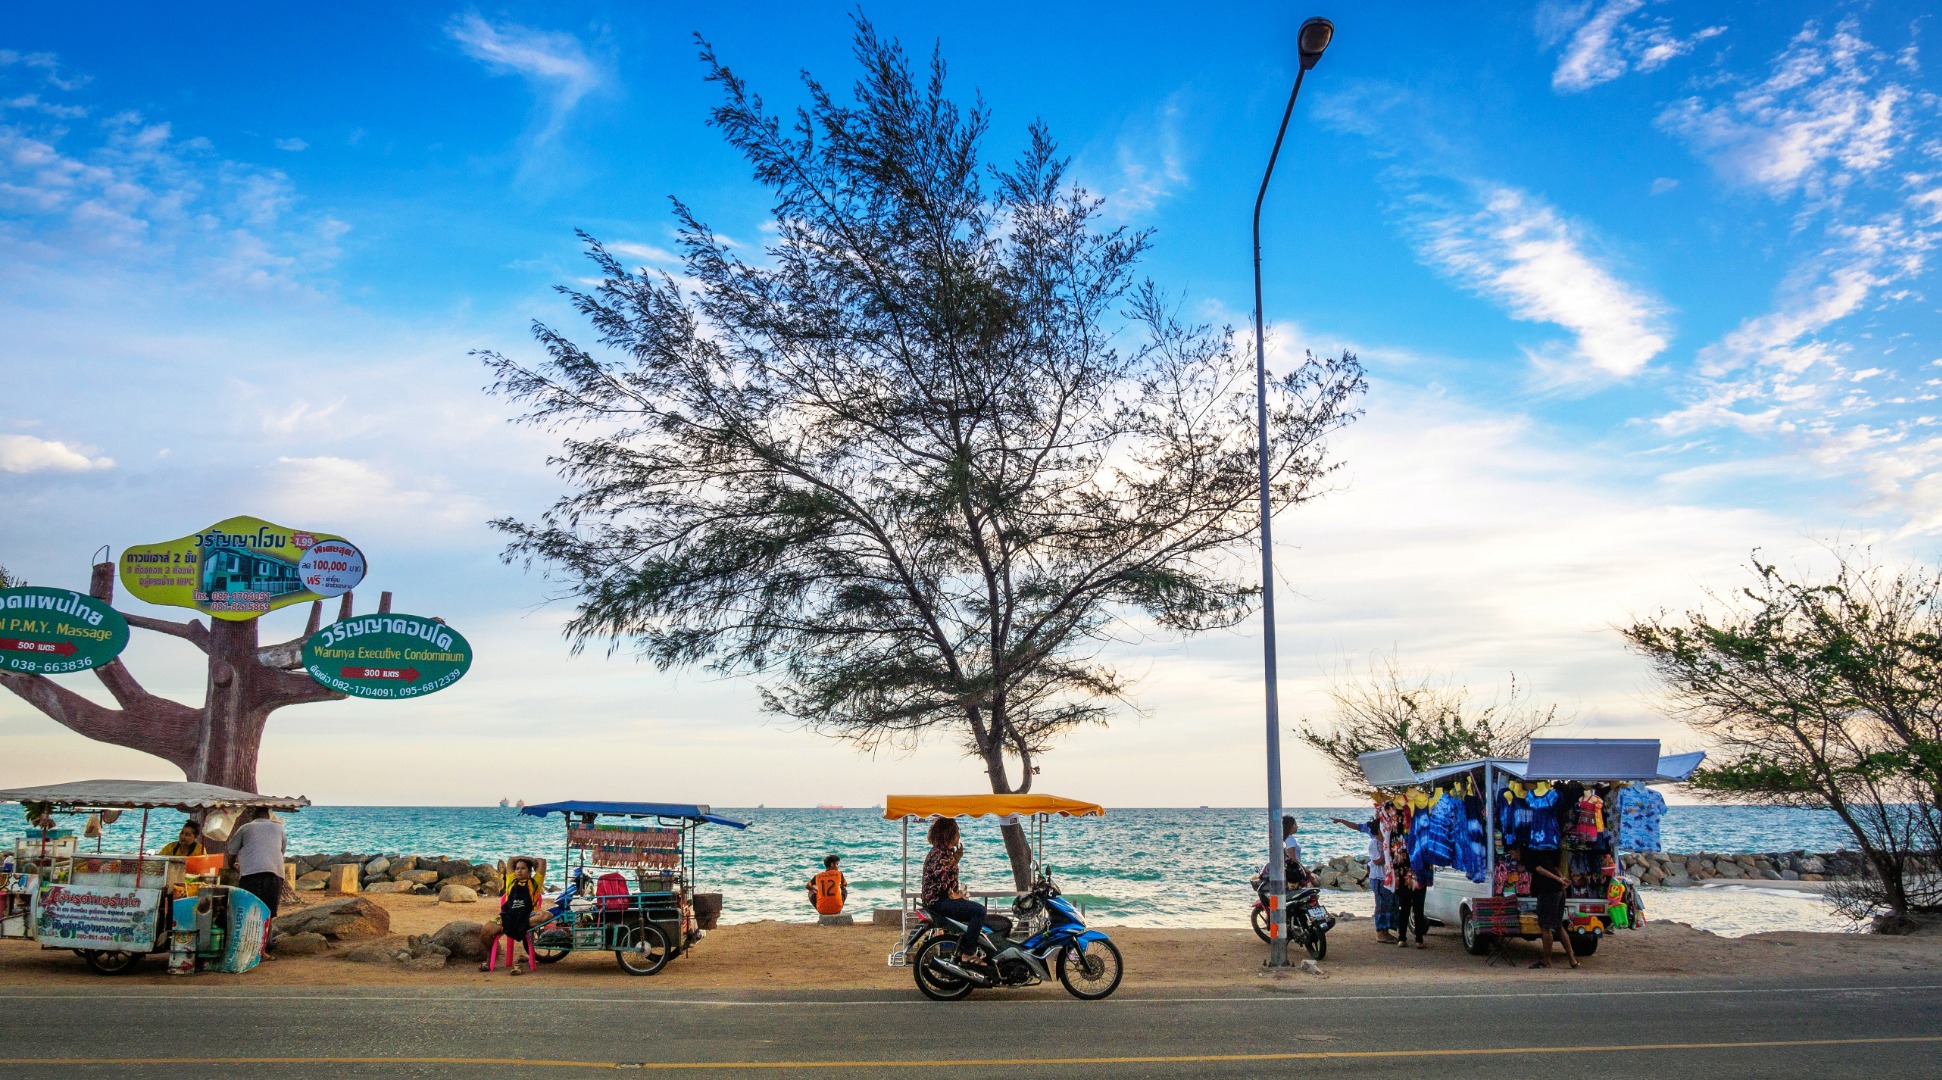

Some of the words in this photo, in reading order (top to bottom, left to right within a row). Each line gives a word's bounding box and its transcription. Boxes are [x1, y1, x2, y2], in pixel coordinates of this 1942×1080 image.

[194, 527, 286, 549] วรัญญาโฮม
[127, 549, 169, 562] ทาวน์เฮาส์
[174, 554, 180, 562] 2
[185, 550, 196, 562] ชั้น
[313, 560, 347, 572] 100,000
[307, 574, 320, 585] ฟรี
[211, 592, 270, 600] 082-1704091
[211, 602, 270, 611] 081-8215869
[10, 618, 51, 633] P.M.Y.
[56, 623, 113, 641] Massage
[314, 646, 354, 660] Warunya
[358, 647, 401, 660] Executive
[404, 648, 464, 662] Condominium
[11, 656, 92, 672] 038-663836
[364, 669, 379, 677] 300
[383, 670, 399, 678] เมตร
[400, 668, 461, 696] 095-6812339
[820, 879, 836, 897] 12
